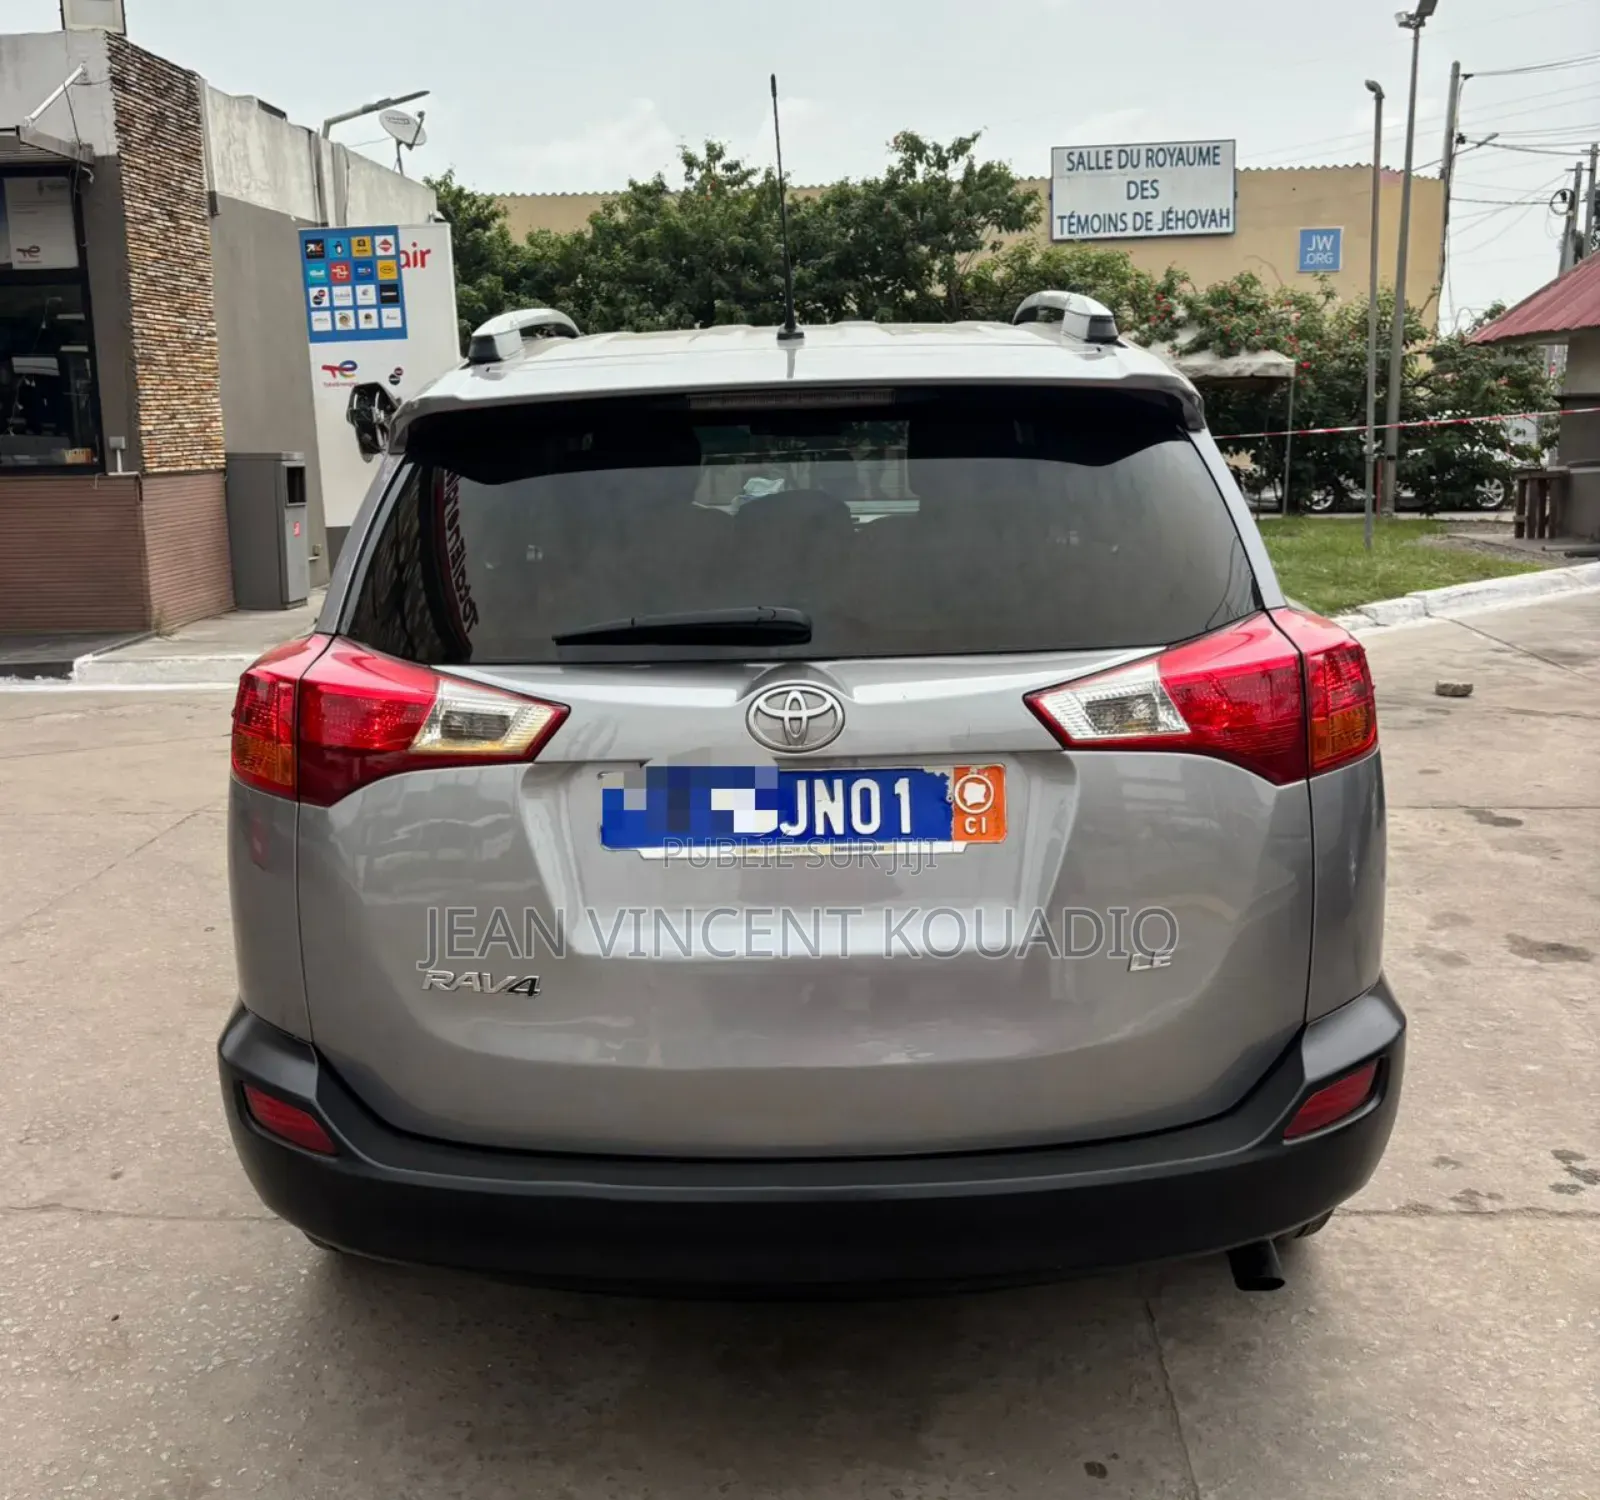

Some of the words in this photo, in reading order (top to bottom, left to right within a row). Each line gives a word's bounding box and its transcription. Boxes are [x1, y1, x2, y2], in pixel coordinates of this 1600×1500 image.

[1066, 149, 1113, 172] SALLE
[1118, 148, 1141, 170] DU
[1145, 146, 1221, 168] ROYAUME
[1126, 179, 1160, 201] DES
[1057, 210, 1128, 235] TÉMOINS
[1132, 211, 1153, 232] DE
[1157, 206, 1230, 232] JÉHOVAH
[1306, 234, 1335, 251] JW
[742, 777, 911, 836] JN01
[963, 816, 988, 835] CI
[1127, 949, 1174, 972] LE
[420, 969, 542, 998] RAV4
